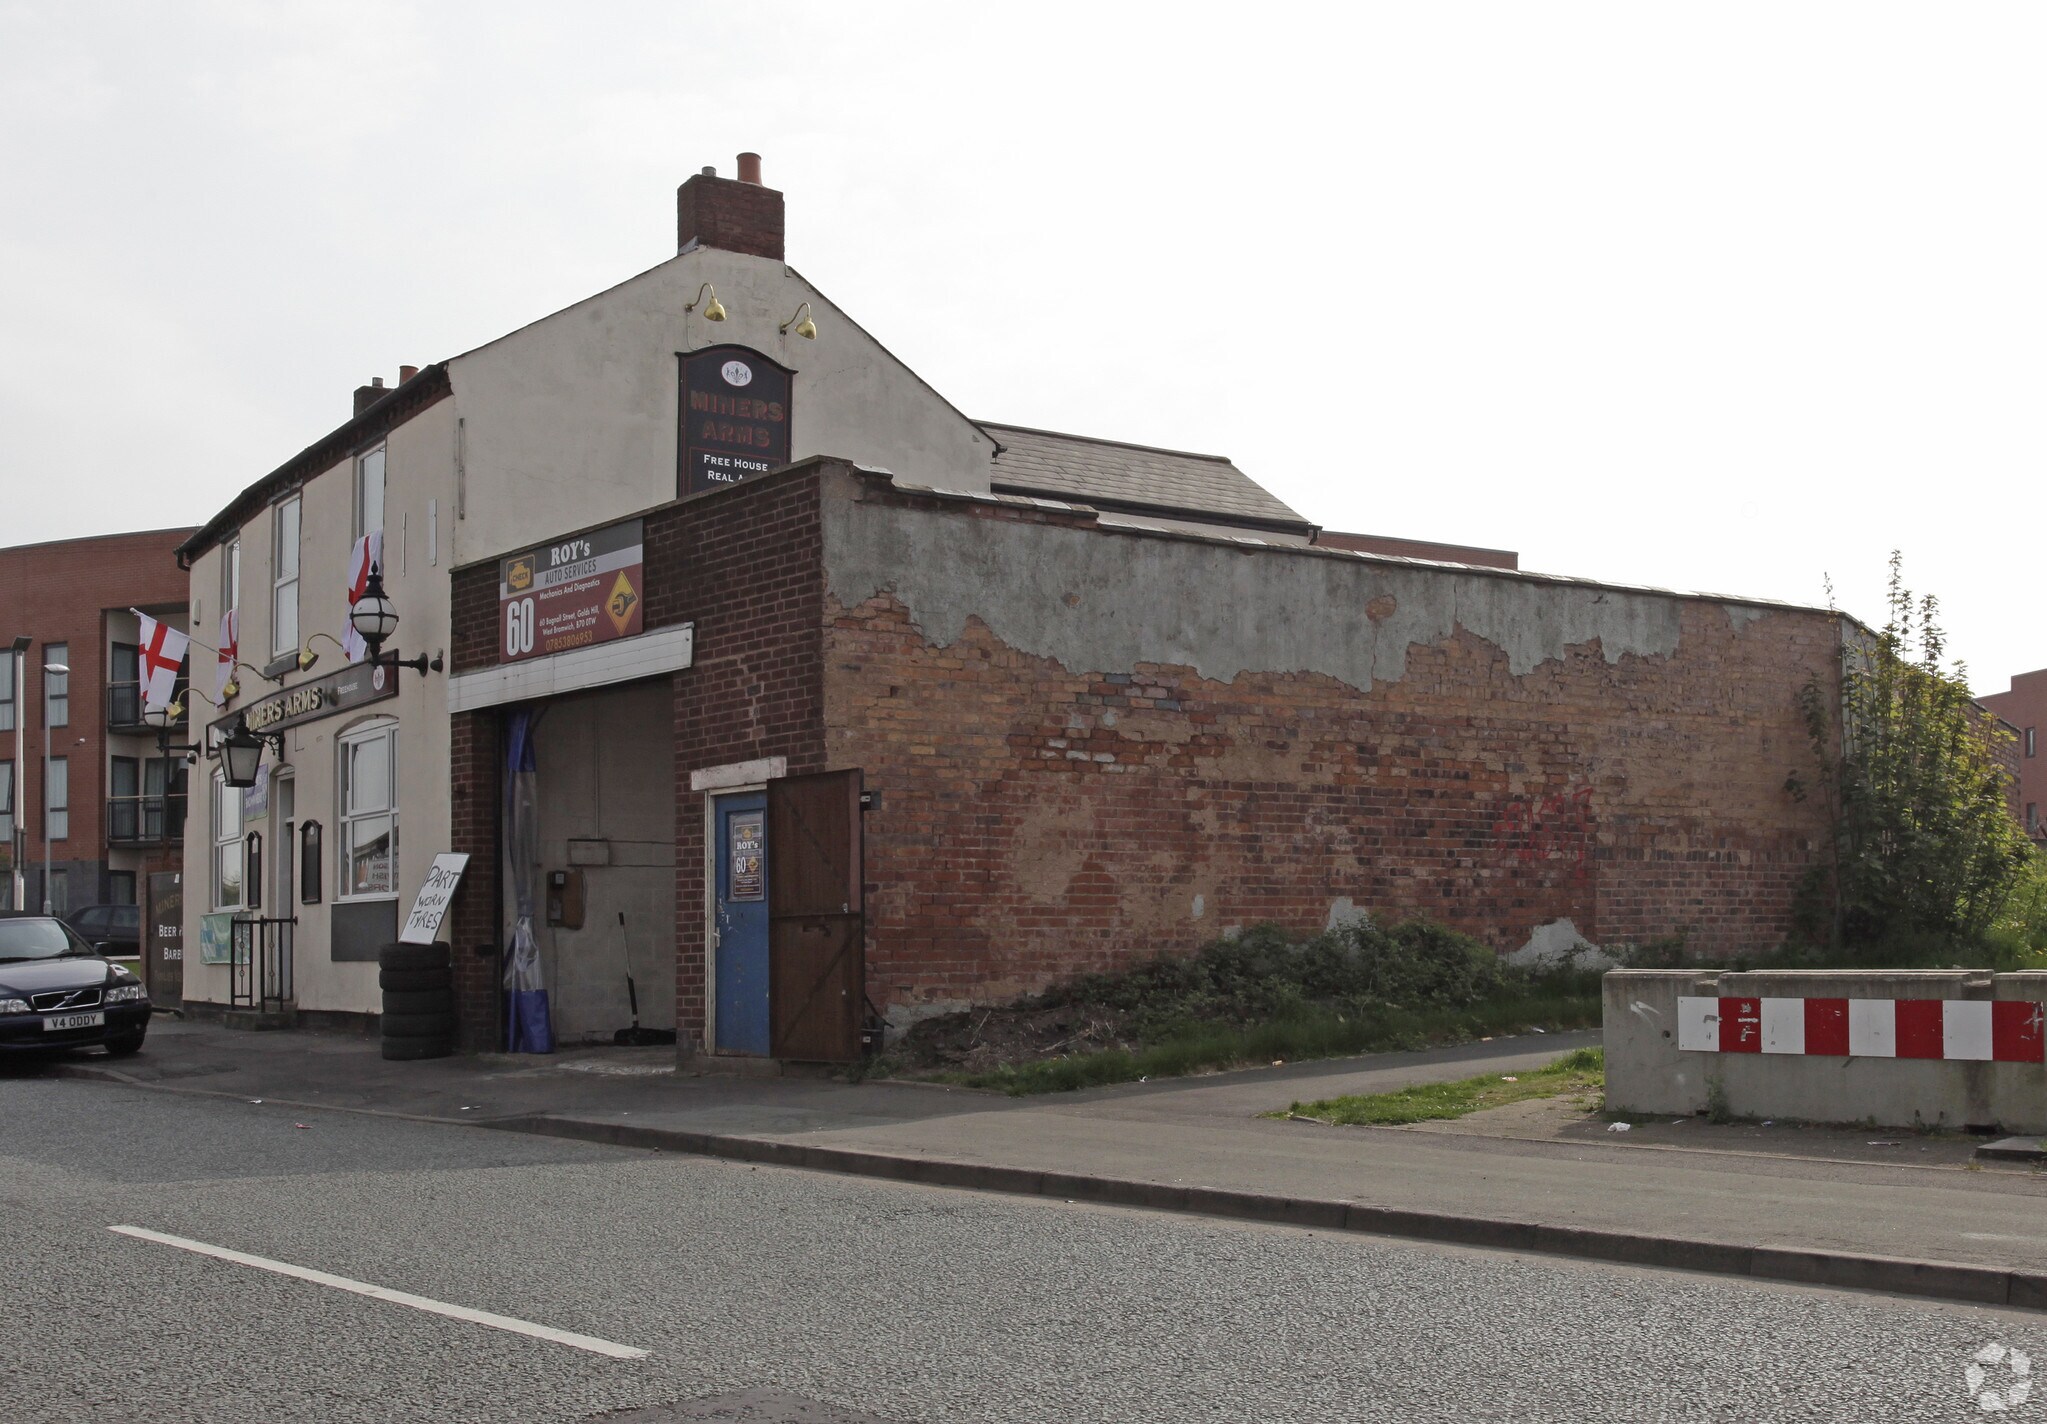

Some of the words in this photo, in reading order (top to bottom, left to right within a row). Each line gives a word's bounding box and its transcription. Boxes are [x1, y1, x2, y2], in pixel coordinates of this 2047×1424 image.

[690, 390, 784, 423] MINERS
[703, 420, 770, 448] ARMS
[703, 454, 731, 467] FREE
[734, 458, 768, 472] HOUSE
[707, 469, 734, 482] REAL
[551, 539, 591, 566] ROY's
[544, 570, 563, 585] AUTO
[564, 559, 597, 580] SERVICES
[539, 589, 563, 601] Mechanics
[563, 584, 573, 594] And
[574, 578, 600, 592] Diagnostics
[506, 597, 535, 657] 60
[284, 687, 321, 718] ARMS
[736, 856, 746, 874] 60
[424, 865, 461, 890] PART
[156, 894, 183, 914] MINER
[418, 893, 446, 907] WORN
[158, 924, 177, 937] BEER
[409, 910, 442, 930] TYRES
[163, 947, 183, 960] BARB
